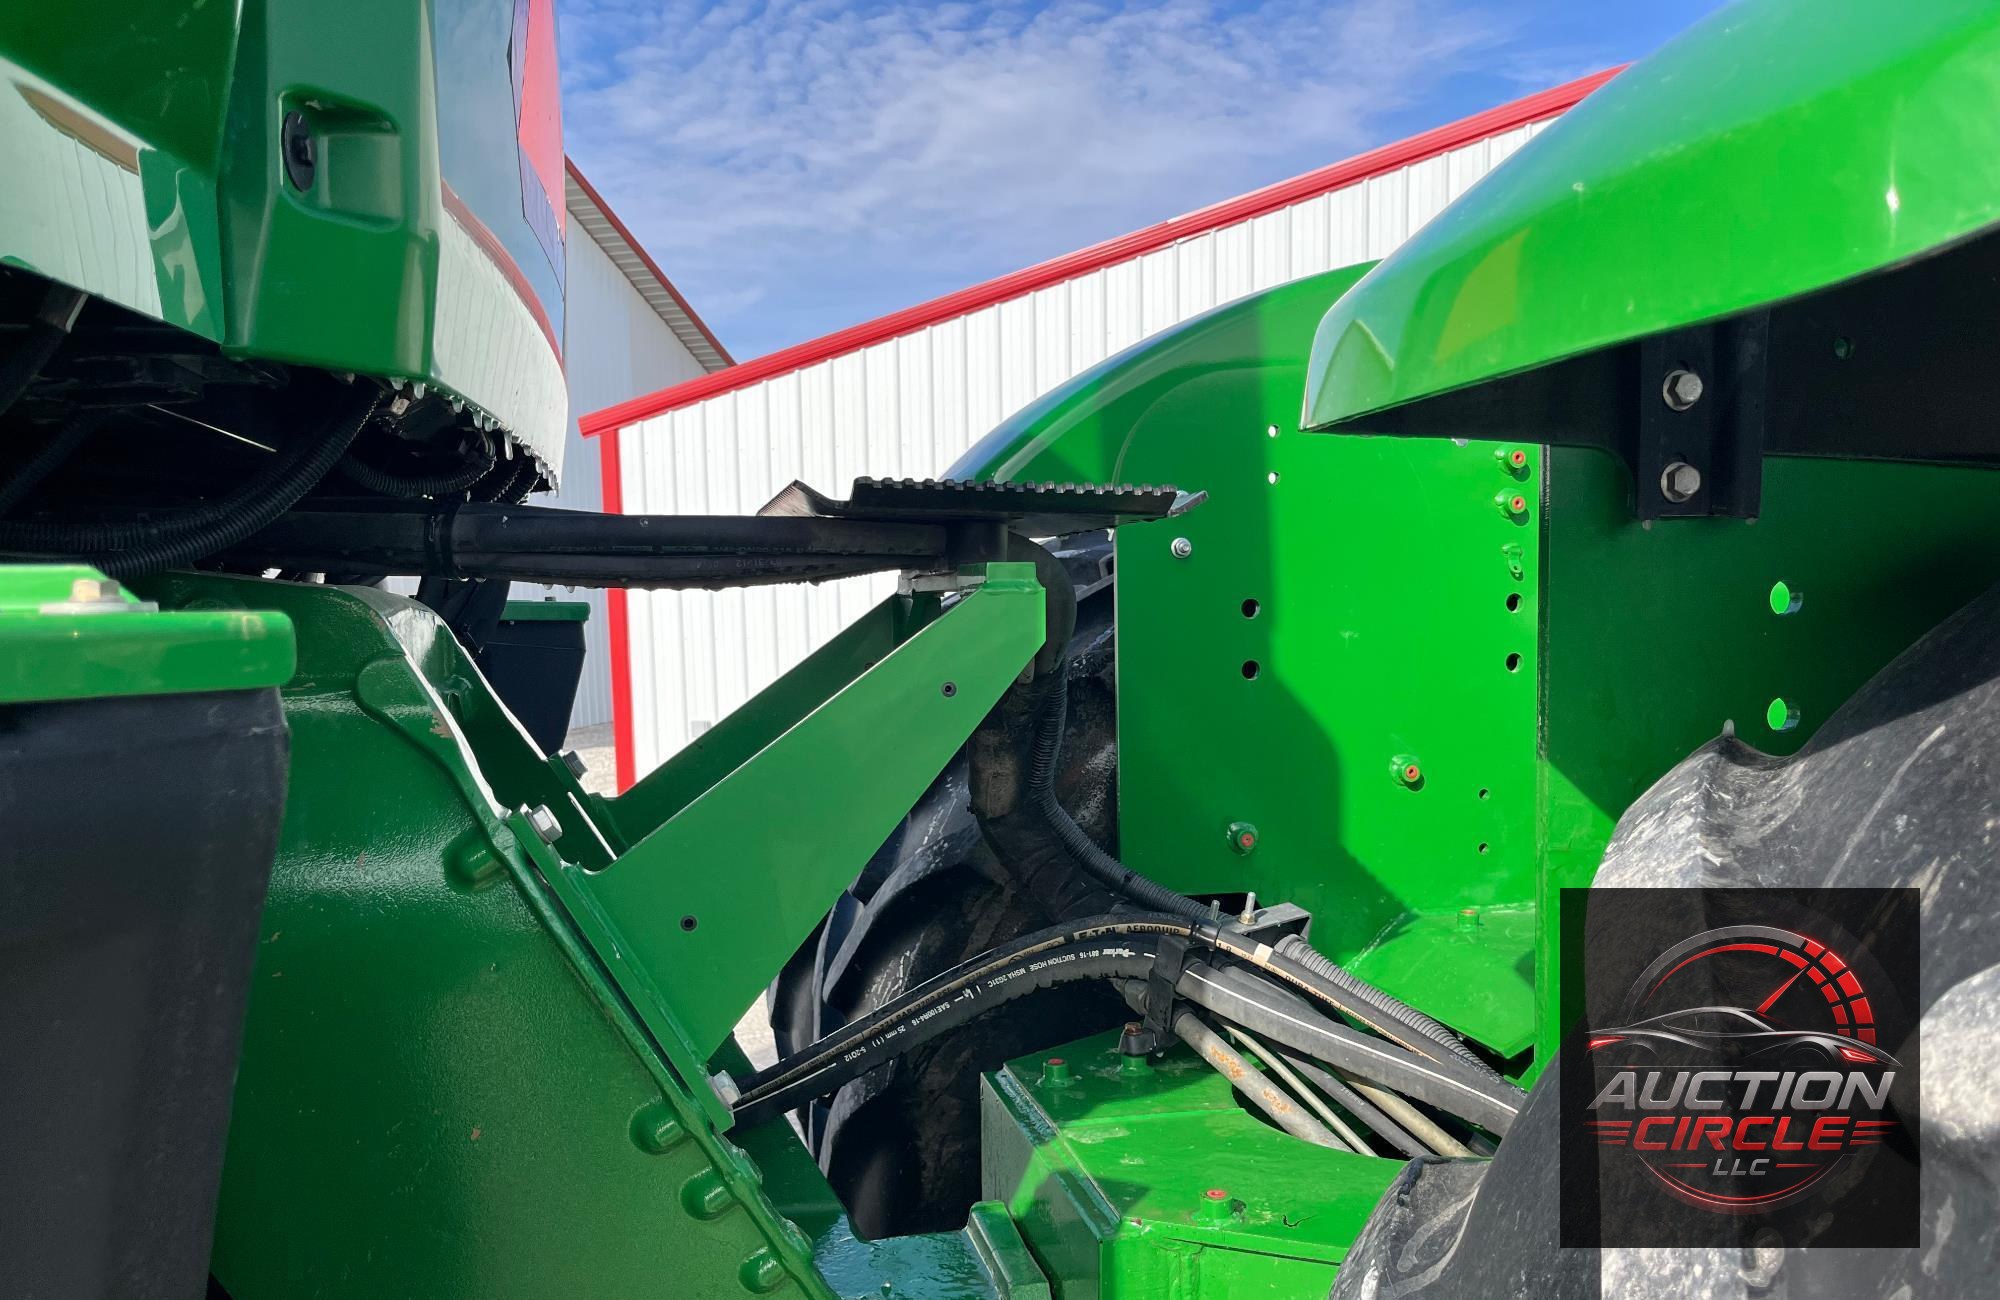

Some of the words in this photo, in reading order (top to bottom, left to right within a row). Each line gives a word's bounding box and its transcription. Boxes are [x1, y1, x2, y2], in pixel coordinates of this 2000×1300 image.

[1029, 958, 1048, 973] HOSE
[1049, 953, 1076, 967] SUCTION
[1007, 967, 1027, 981] MSHA
